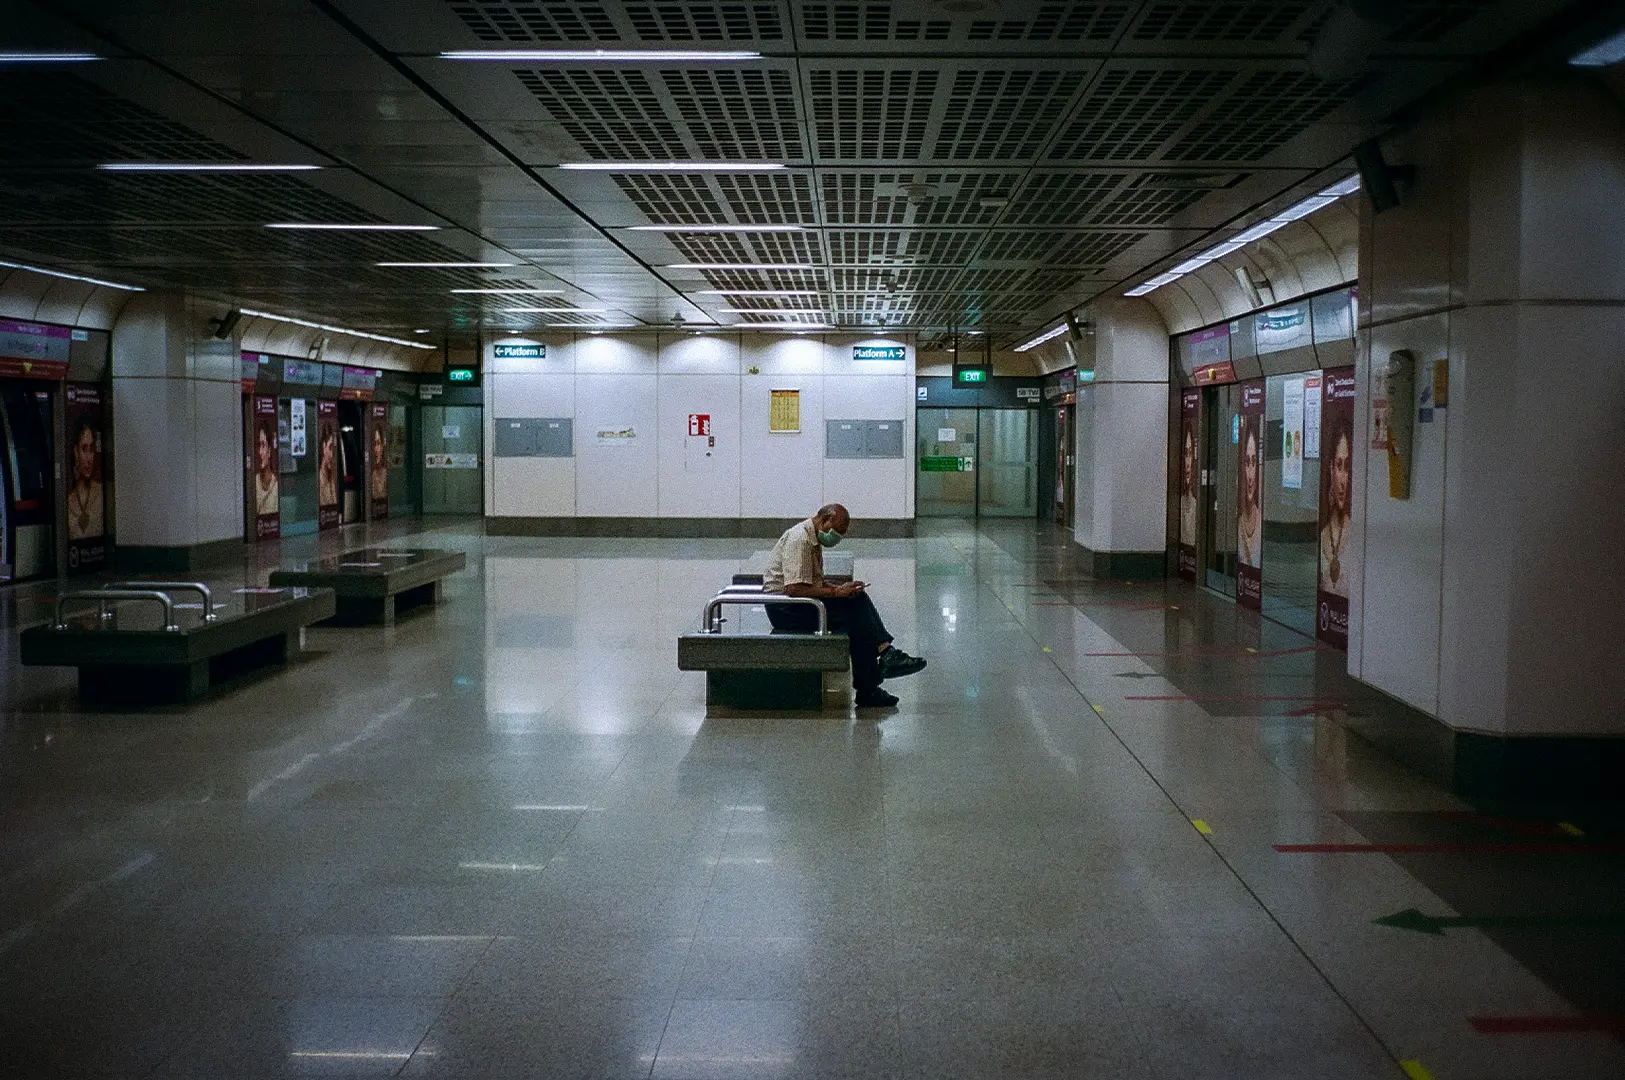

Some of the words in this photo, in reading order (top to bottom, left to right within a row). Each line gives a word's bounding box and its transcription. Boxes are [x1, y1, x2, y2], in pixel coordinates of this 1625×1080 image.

[504, 347, 538, 356] Platform
[539, 347, 545, 356] B
[854, 348, 888, 358] Platform
[888, 349, 895, 358] A
[450, 371, 464, 381] EXIT
[965, 371, 980, 381] EXIT
